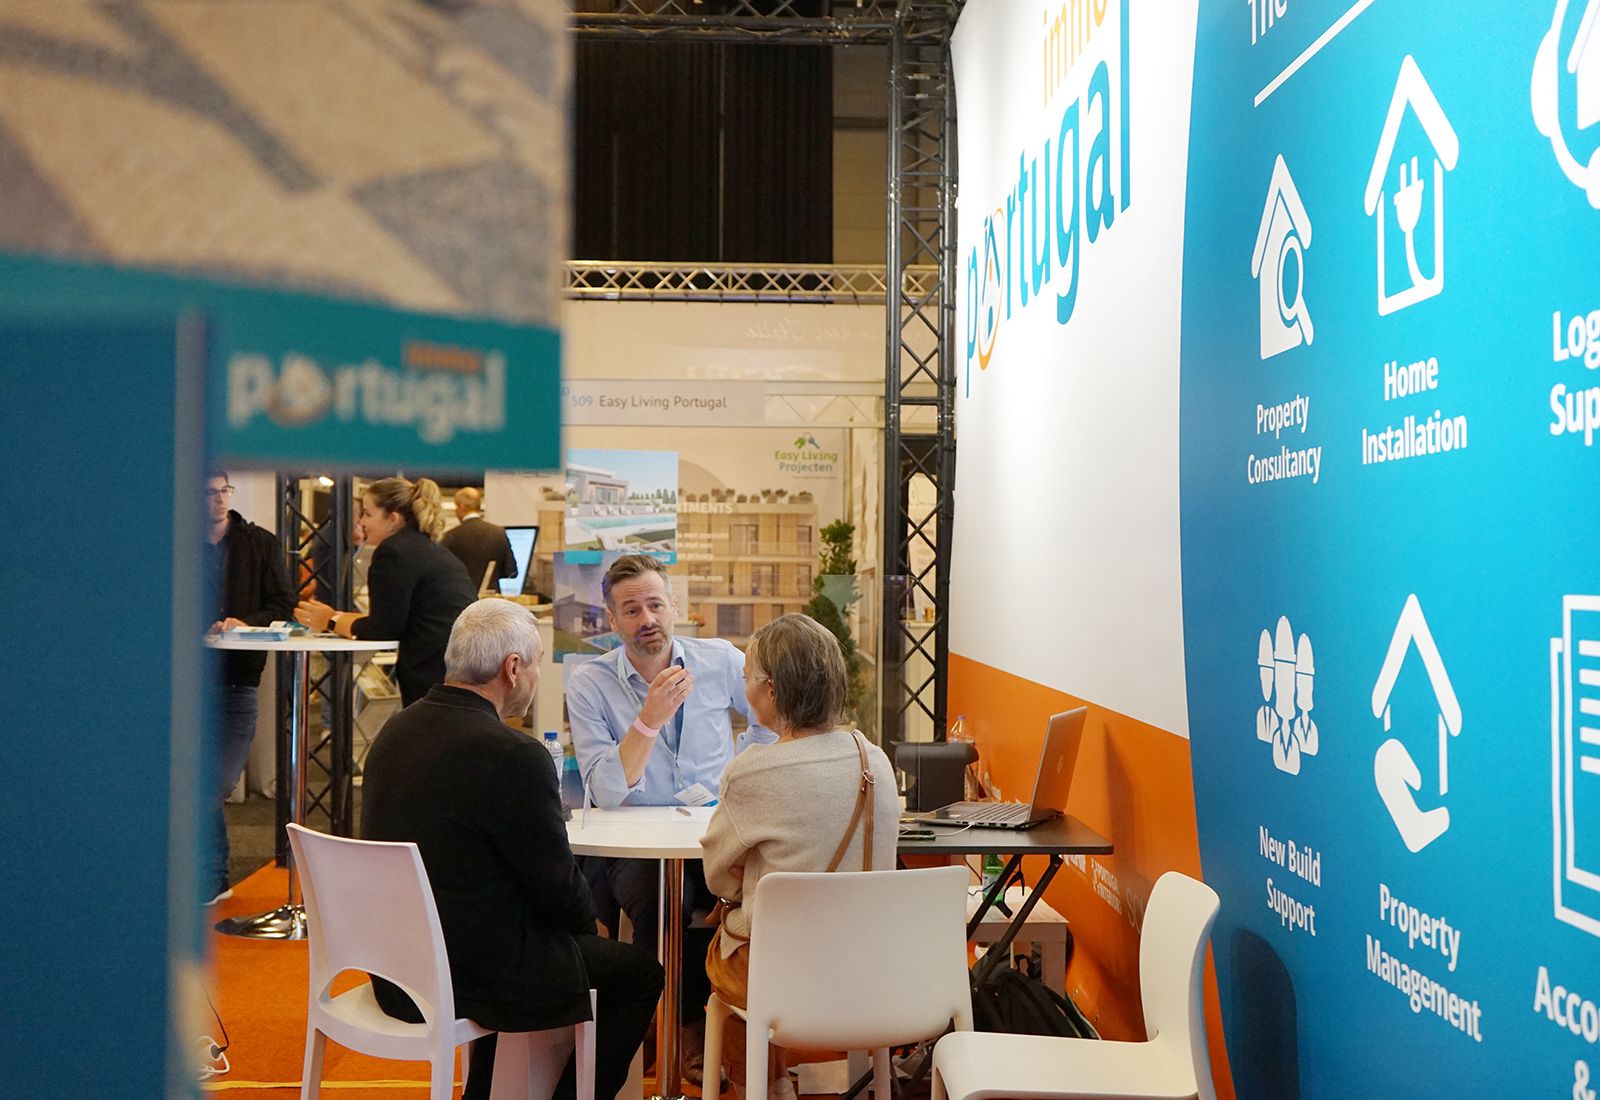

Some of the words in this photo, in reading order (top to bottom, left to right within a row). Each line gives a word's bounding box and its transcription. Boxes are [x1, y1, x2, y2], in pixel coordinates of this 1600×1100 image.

[1043, 0, 1108, 109] imm
[966, 0, 1130, 398] portugal
[571, 396, 593, 408] 509
[599, 395, 627, 410] Easy
[631, 395, 670, 410] Living
[673, 396, 727, 412] Portugal
[1383, 356, 1438, 401] Home
[1256, 394, 1310, 439] Property
[1362, 409, 1467, 465] Installation
[1549, 383, 1600, 447] Sup
[774, 450, 799, 463] Easy
[801, 450, 839, 464] Living
[779, 462, 833, 474] Projecten
[1247, 445, 1322, 485] Consultancy
[677, 502, 733, 515] TMENTS
[1259, 825, 1285, 867] New
[1288, 839, 1321, 887] Build
[1266, 877, 1316, 937] Support
[1379, 883, 1461, 972] Property
[1366, 934, 1482, 1043] Management
[1533, 966, 1600, 1043] Acco
[1572, 1060, 1597, 1100] &
